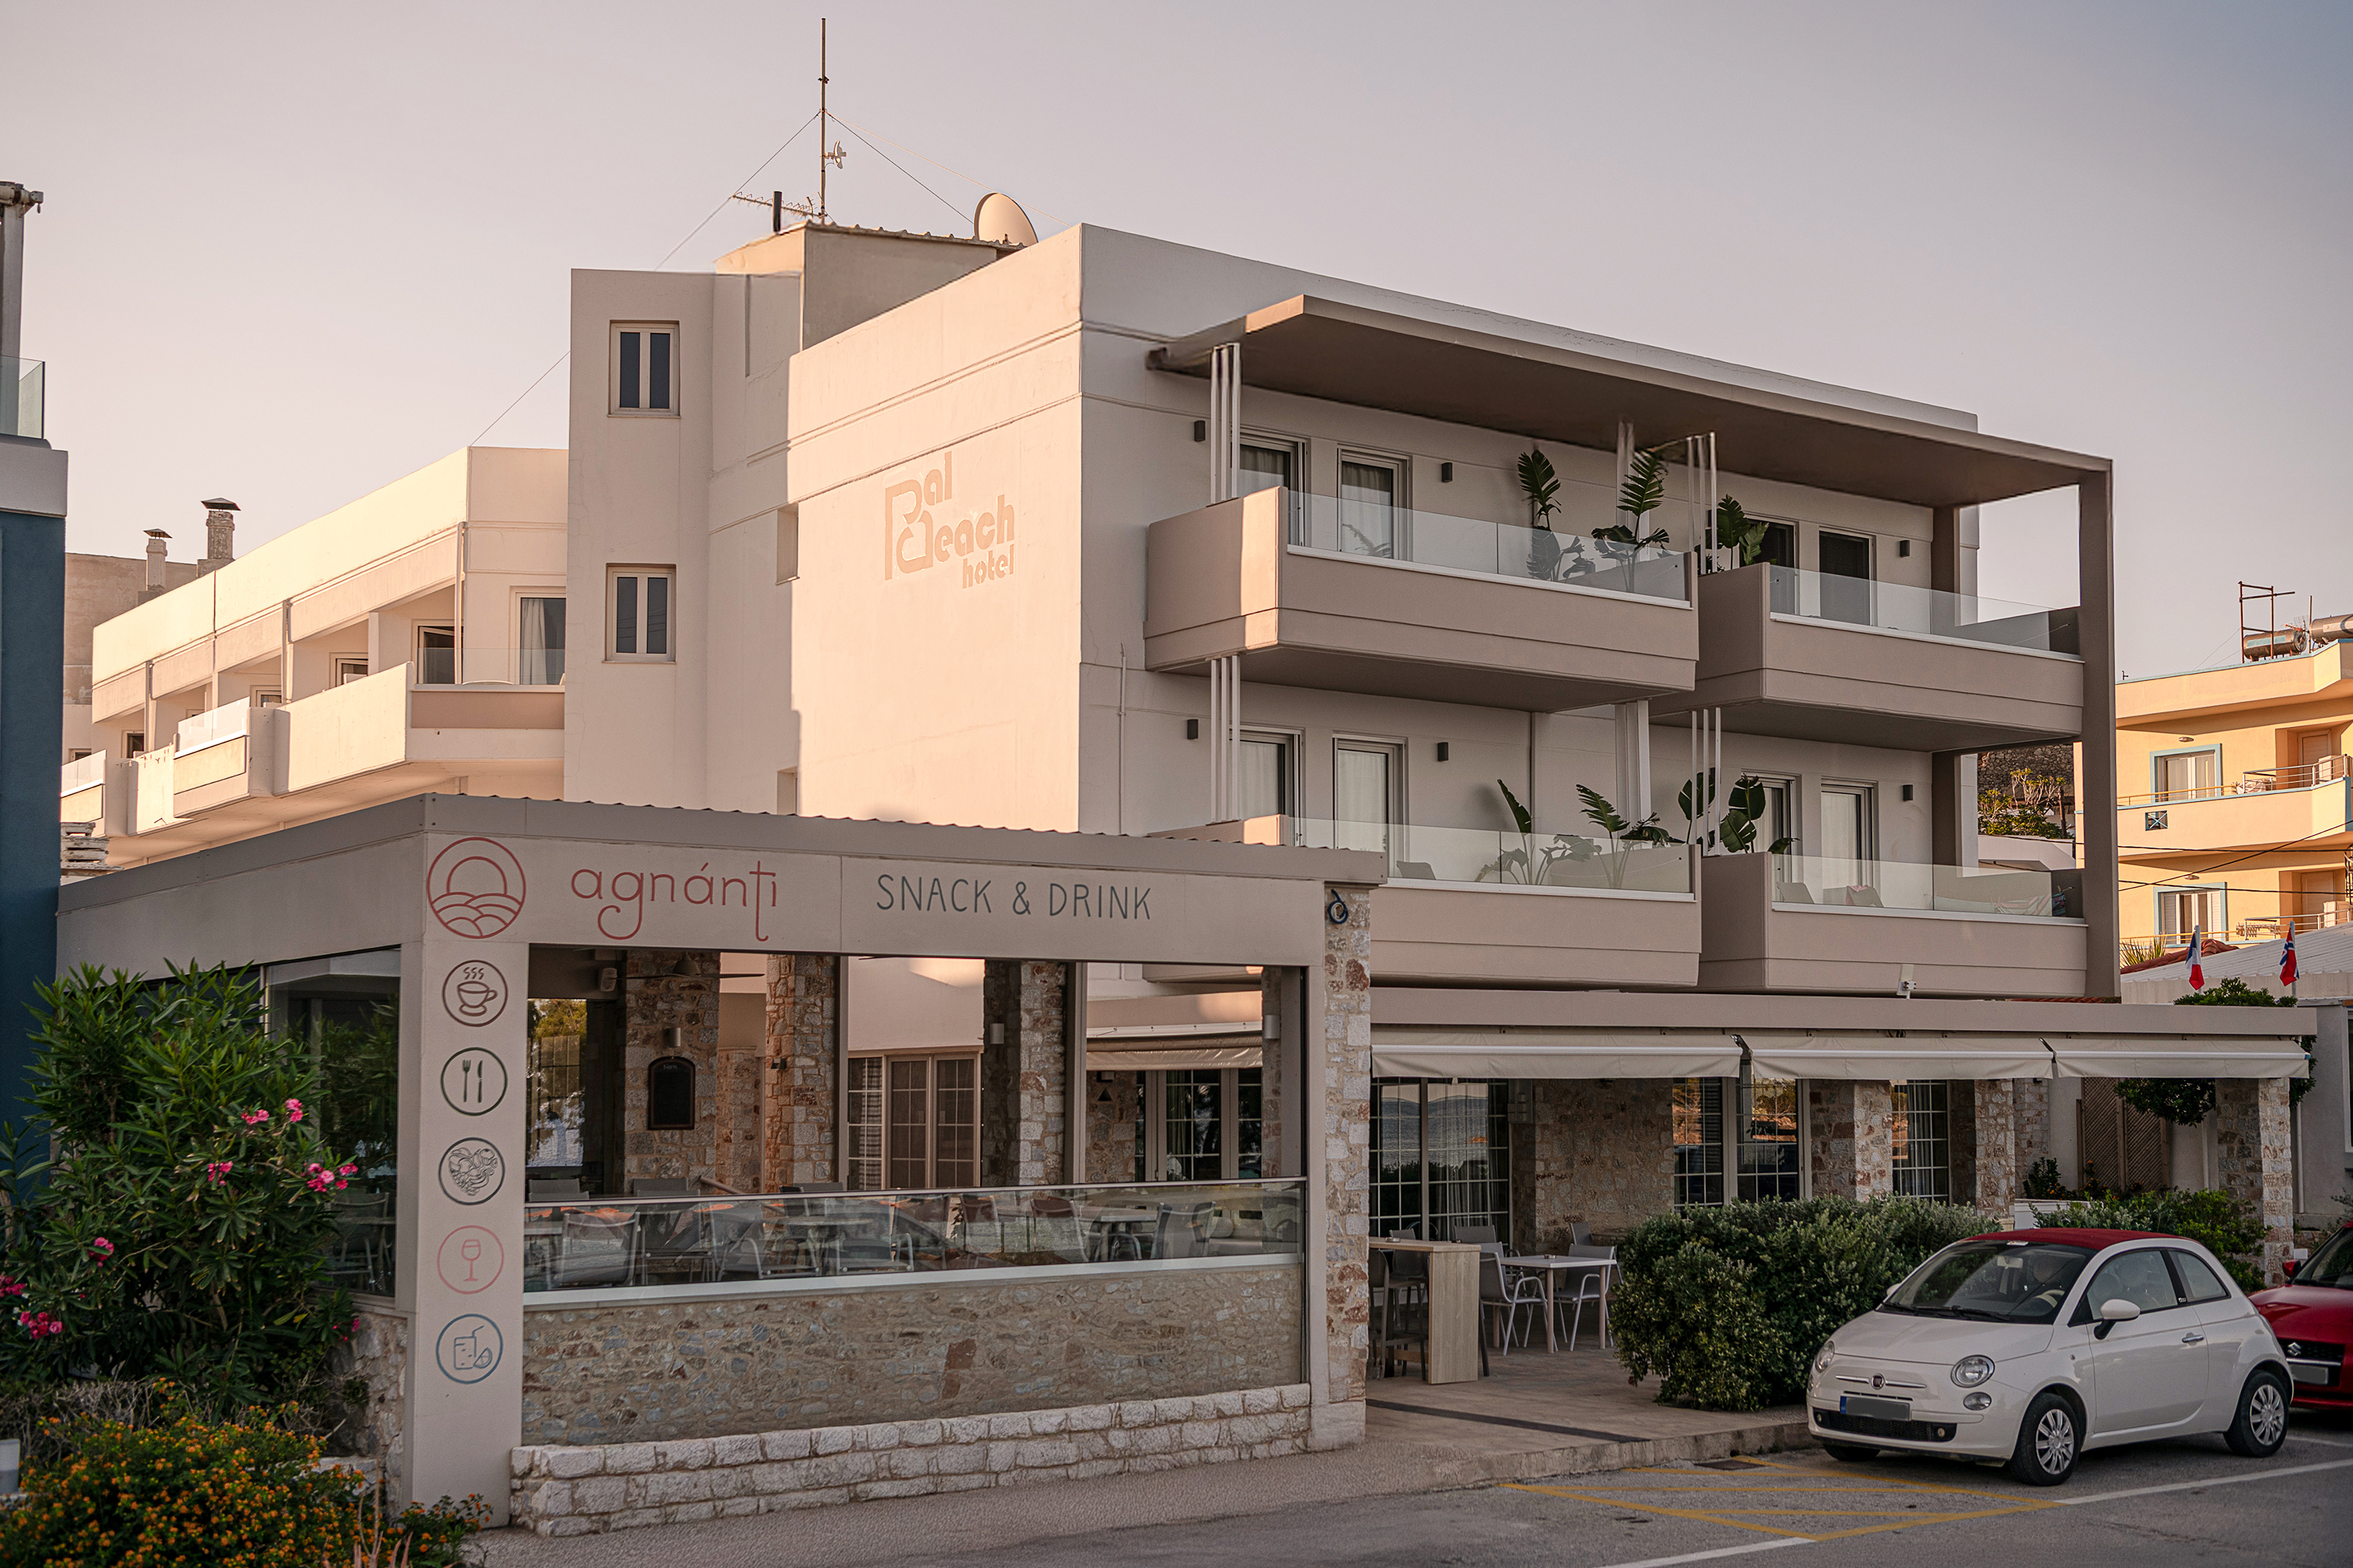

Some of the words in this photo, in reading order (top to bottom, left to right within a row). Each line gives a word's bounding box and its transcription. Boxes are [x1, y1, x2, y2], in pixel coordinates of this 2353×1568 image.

[962, 543, 1014, 589] hotel
[571, 860, 776, 942] agnánti
[876, 874, 992, 914] SNACK
[1013, 881, 1031, 915] &
[1049, 883, 1151, 920] DRINK
